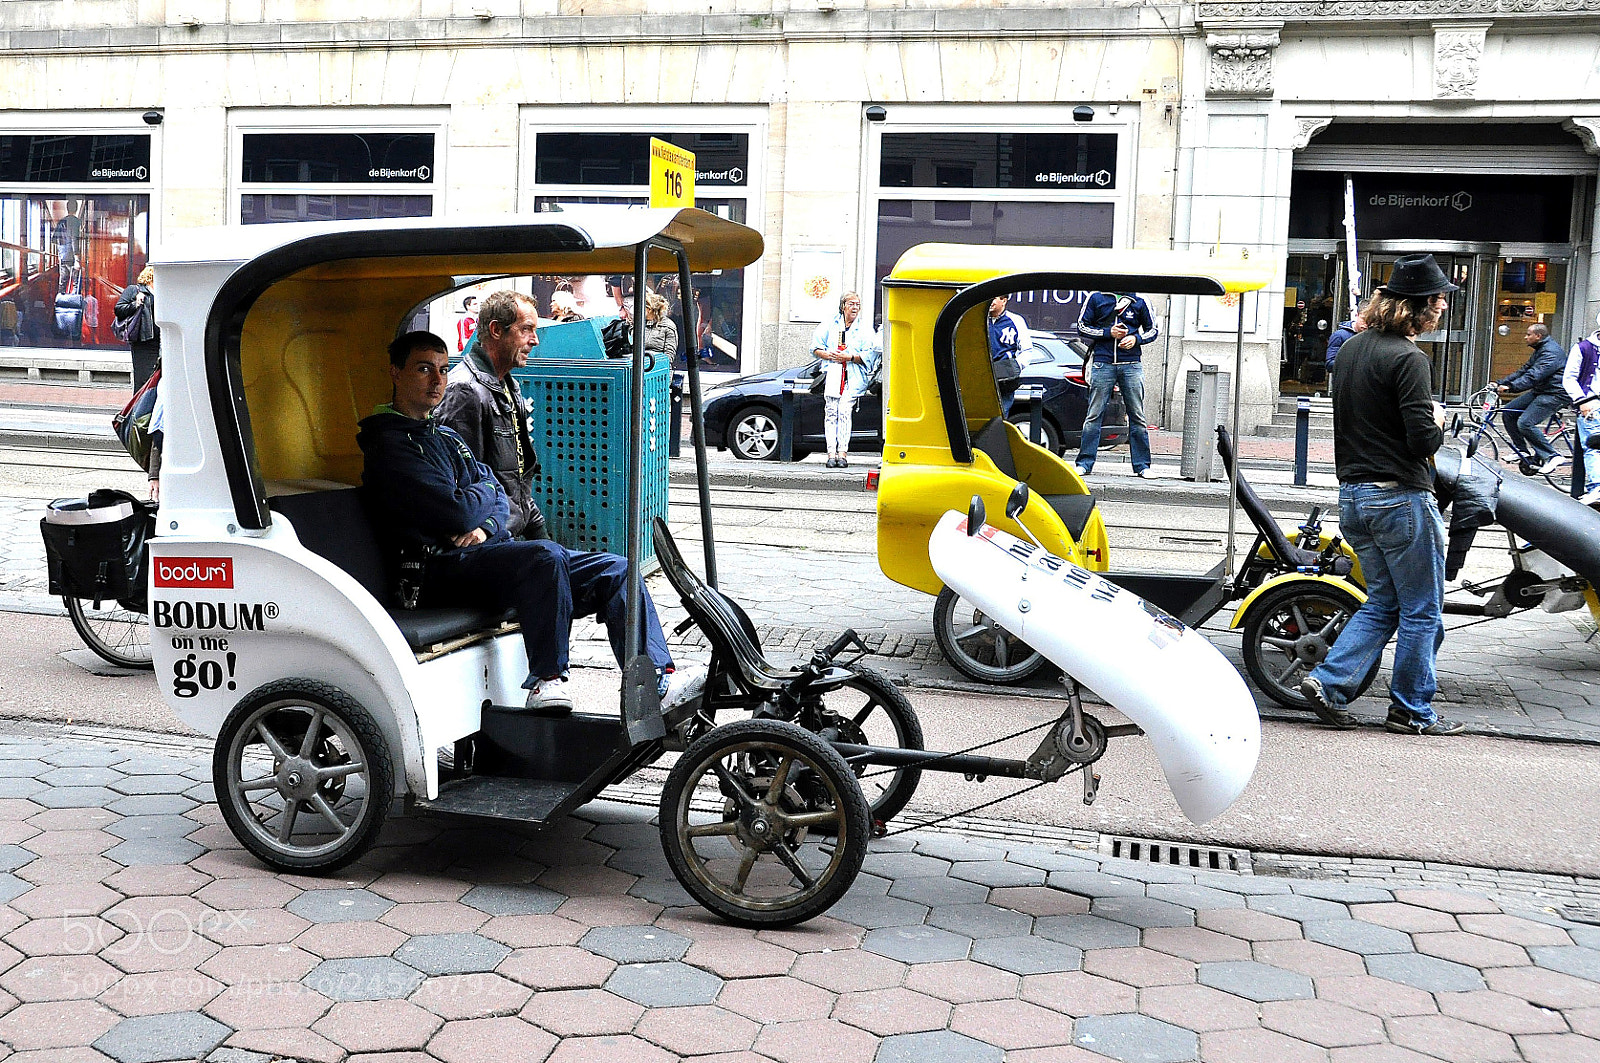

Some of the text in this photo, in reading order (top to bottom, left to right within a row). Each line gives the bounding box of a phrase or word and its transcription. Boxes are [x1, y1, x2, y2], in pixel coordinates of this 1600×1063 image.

[92, 169, 135, 178] de Bijenkorf
[369, 168, 417, 178] de Bijenkorf
[695, 170, 728, 181] ijenkorf
[1035, 173, 1094, 184] de Bijenkorf
[664, 168, 683, 199] 116
[1369, 194, 1449, 208] de Bijenkorf
[159, 561, 227, 581] bodum
[171, 634, 229, 651] on the
[173, 651, 237, 698] go!
